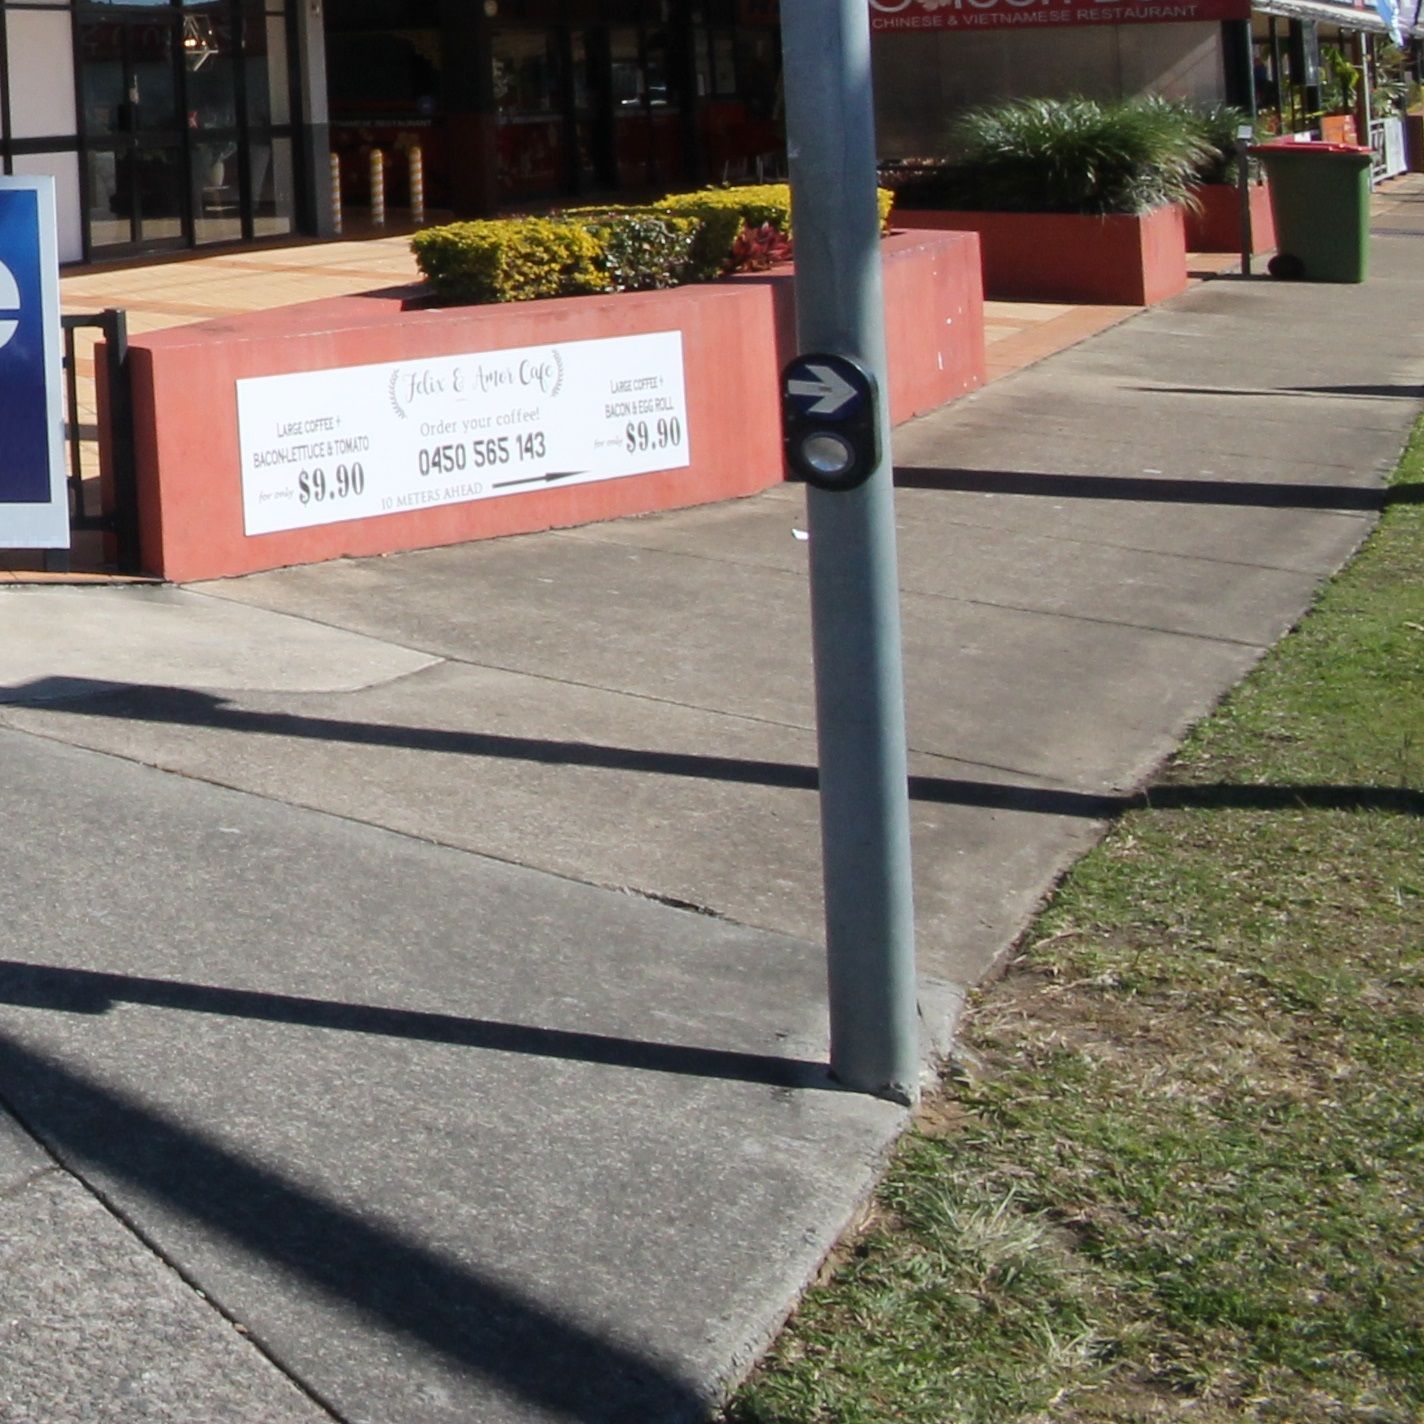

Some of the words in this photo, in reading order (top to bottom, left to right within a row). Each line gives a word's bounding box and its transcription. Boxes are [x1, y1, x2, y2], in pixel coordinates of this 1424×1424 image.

[872, 15, 942, 29] CHINESE
[947, 15, 958, 26] &
[963, 10, 1071, 26] VIETNAMESE
[1077, 5, 1197, 21] RESTAURANT
[404, 369, 445, 403] Felix
[519, 359, 553, 393] Cafe
[610, 380, 632, 394] LARGE
[633, 376, 658, 391] COFFEE
[420, 420, 457, 437] Order
[462, 416, 492, 434] your
[496, 407, 541, 427] coffee!
[605, 401, 631, 419] BACON
[638, 398, 654, 414] EGG
[655, 396, 674, 412] ROLL
[276, 421, 303, 438] LARGE
[304, 417, 334, 434] COFFEE
[626, 416, 681, 456] $9.90
[253, 442, 325, 469] BACON-LETTUCE
[327, 441, 333, 457] &
[334, 435, 370, 455] TOMATO
[418, 443, 466, 476] 0450
[473, 436, 510, 468] 565
[515, 431, 546, 461] 143
[298, 462, 364, 508] $9.90
[381, 497, 393, 510] 10
[397, 488, 441, 508] METERS
[443, 481, 483, 500] AHEAD
